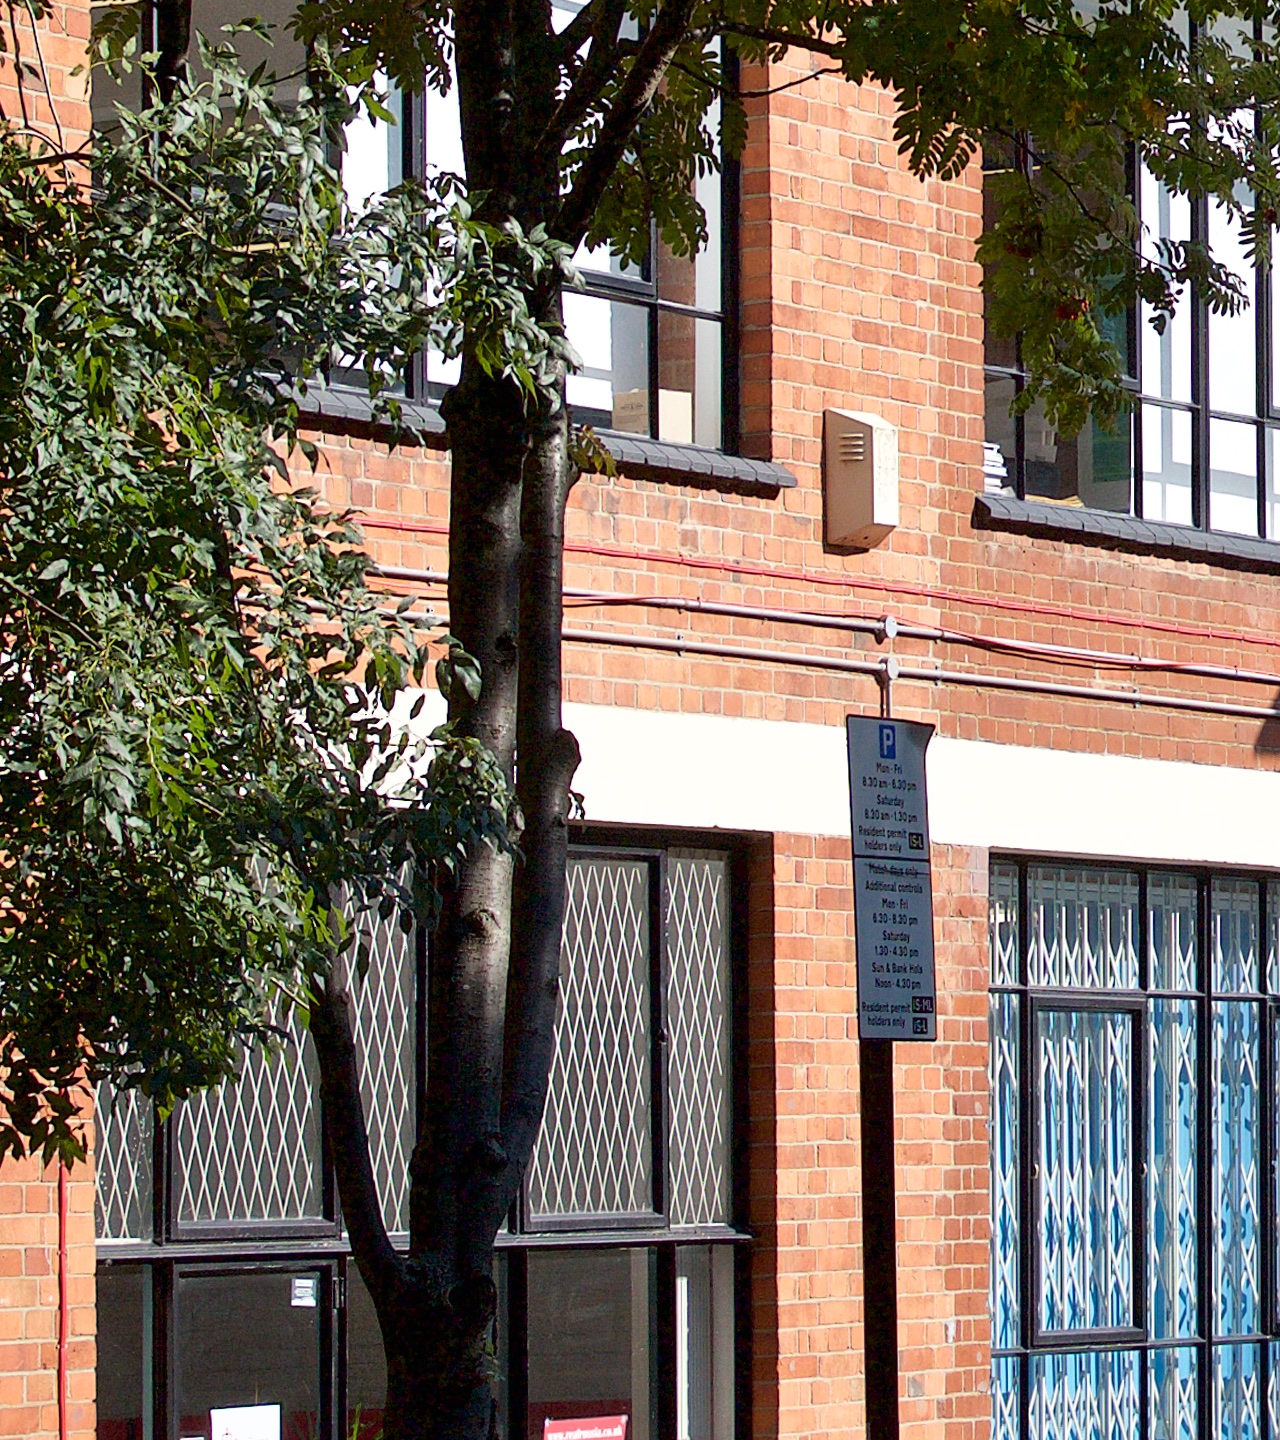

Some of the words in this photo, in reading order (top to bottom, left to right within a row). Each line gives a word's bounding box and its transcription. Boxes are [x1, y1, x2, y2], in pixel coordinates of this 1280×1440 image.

[882, 729, 894, 756] P
[877, 762, 889, 773] Mon
[894, 764, 902, 774] Fri
[876, 794, 904, 809] Saturday
[858, 825, 886, 837] Resident
[886, 829, 907, 840] permit
[864, 840, 888, 851] holders
[889, 843, 902, 853] only
[865, 881, 897, 892] Additional
[898, 883, 923, 893] controls
[881, 898, 895, 909] Mon
[900, 900, 909, 909] Fri
[908, 917, 918, 926] pm
[882, 930, 910, 944] Saturday
[874, 946, 888, 956] 1.30
[893, 946, 907, 957] 4.30
[910, 949, 919, 958] pm
[872, 963, 884, 973] Sun
[892, 964, 907, 974] Bank
[875, 979, 892, 989] Noon
[896, 979, 911, 989] 4.30
[911, 981, 921, 990] pm
[862, 1001, 889, 1012] Resident
[890, 1003, 911, 1014] permit
[867, 1016, 891, 1026] holders
[892, 1018, 906, 1029] only
